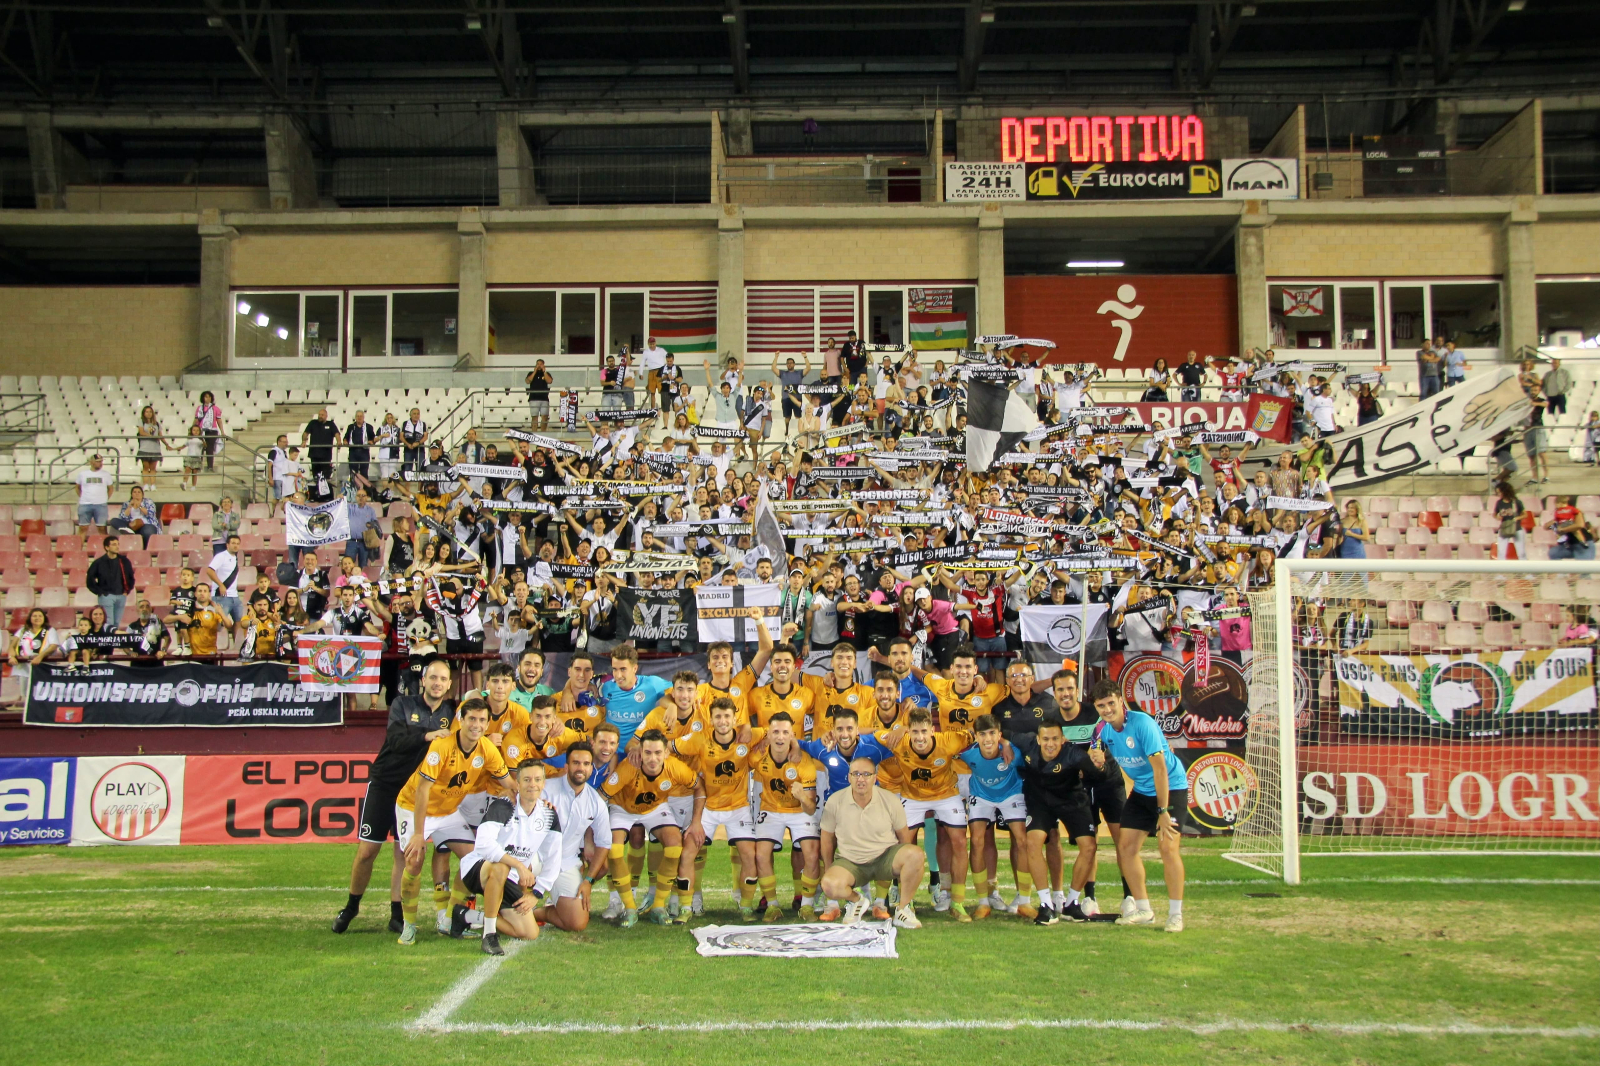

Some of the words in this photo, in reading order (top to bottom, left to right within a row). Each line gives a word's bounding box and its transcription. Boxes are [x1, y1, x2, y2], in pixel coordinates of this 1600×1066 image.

[1001, 115, 1204, 163] DEPORTIVA
[961, 176, 1012, 188] 24H
[1099, 171, 1184, 188] EUROCAM
[1232, 180, 1284, 190] MAN
[1151, 406, 1246, 430] RIOJA
[699, 426, 746, 438] UNIONISTAS
[518, 430, 571, 450] UNIONISTAS
[826, 445, 852, 454] FUTBOL
[404, 470, 450, 482] UNIONISTA
[544, 485, 595, 496] UNIONISTAS
[619, 486, 648, 494] FUTBOL
[650, 485, 684, 494] POPULAR
[312, 499, 345, 511] UNAMUN
[483, 500, 512, 508] FUTBOL
[512, 501, 548, 511] POPULAR
[872, 516, 902, 524] FUTBOL
[904, 515, 943, 523] POPULAR
[718, 523, 752, 535] UNIONIS
[292, 536, 338, 545] UNIONISTAS
[846, 540, 885, 550] POPULAR
[1226, 536, 1262, 544] POPULAR
[894, 552, 925, 564] FUTBOL
[934, 546, 965, 559] POPULAR
[552, 564, 560, 572] IN
[975, 560, 987, 568] SE
[988, 560, 1016, 568] RINDE
[1056, 560, 1092, 569] FUTBOL
[1094, 558, 1136, 568] POPULAR
[698, 592, 730, 600] MADRID
[698, 606, 765, 619] EXCLUIDS
[767, 606, 779, 616] 37
[628, 622, 689, 640] UNIONISTAS
[76, 636, 85, 644] IN
[86, 636, 128, 644] MEMORIAM
[1340, 662, 1374, 682] USCF
[1380, 662, 1416, 682] FANS
[1514, 660, 1536, 681] ON
[1546, 657, 1588, 680] TOUR
[1126, 672, 1138, 698] SOCIEDAD
[1138, 663, 1169, 673] DEPORTIVA
[32, 681, 174, 704] UNIONISTAS
[201, 678, 256, 704] PAÍS
[228, 706, 250, 718] PEÑA
[252, 707, 279, 716] OSKAR
[1184, 714, 1244, 735] Modern
[1194, 755, 1229, 772] DEPORTIVA
[242, 760, 286, 784] EL
[104, 782, 147, 796] PLAY
[1302, 772, 1387, 820] SD
[10, 826, 65, 840] Servicios
[400, 820, 408, 835] 8
